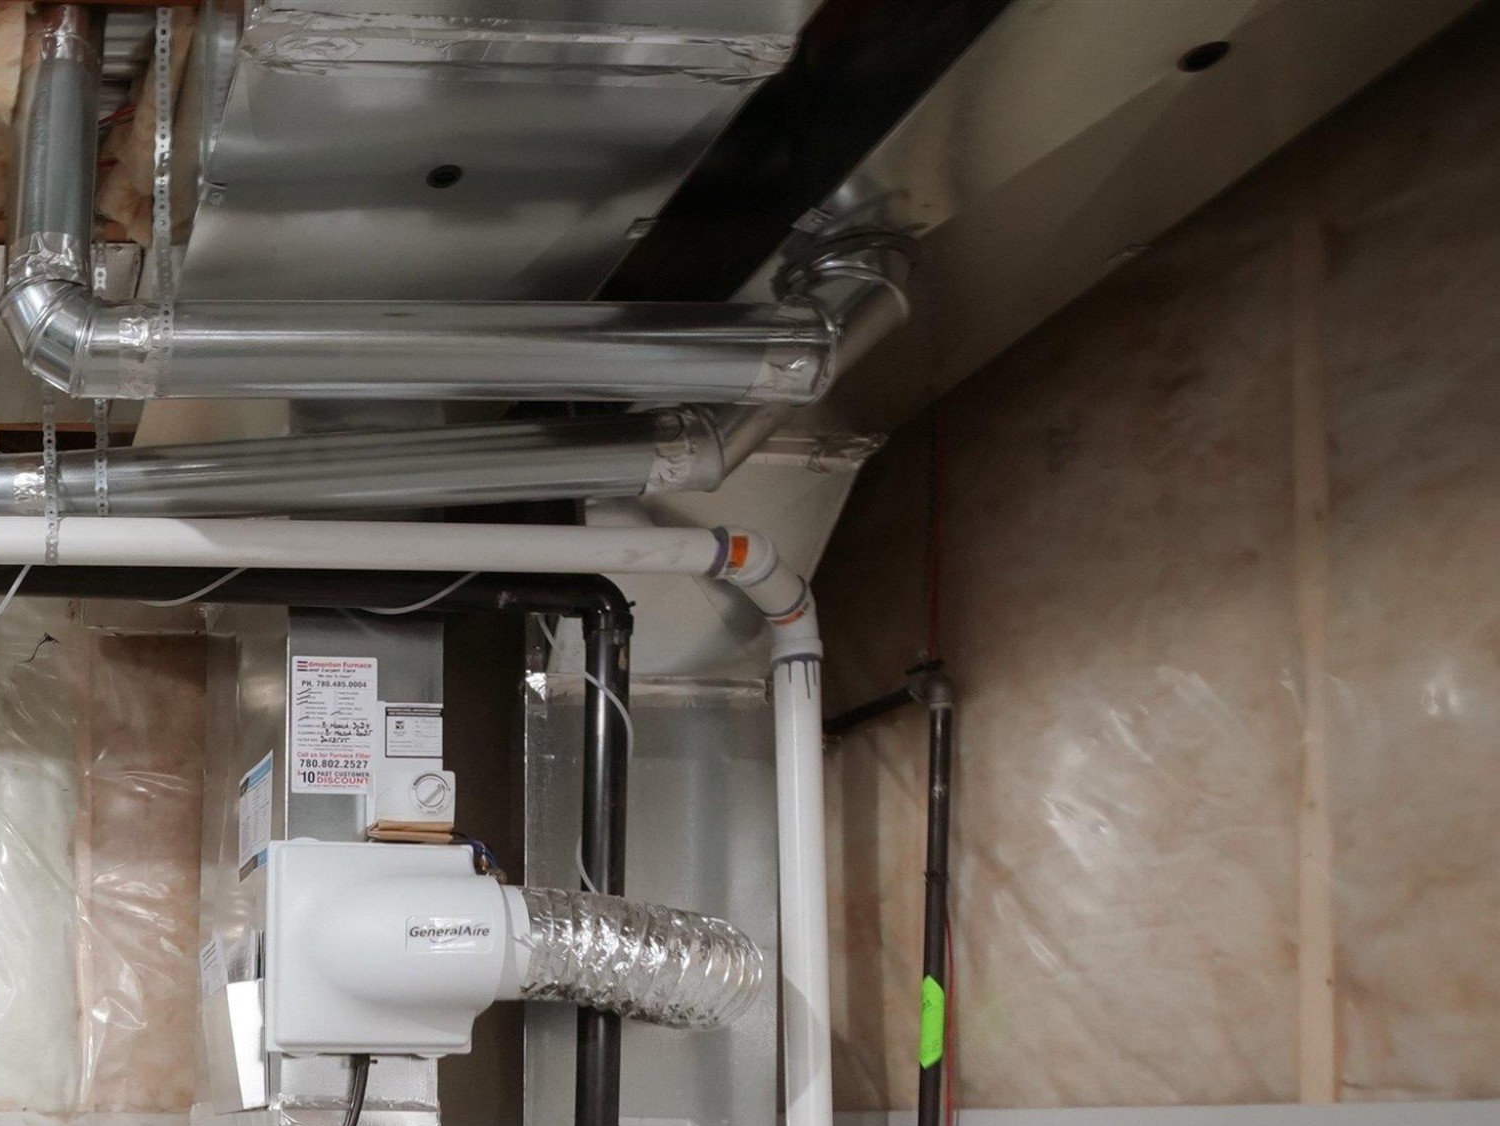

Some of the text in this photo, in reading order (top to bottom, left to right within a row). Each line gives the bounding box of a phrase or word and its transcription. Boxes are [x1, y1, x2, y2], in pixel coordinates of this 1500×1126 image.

[300, 759, 369, 769] 780.802.2527
[316, 777, 369, 785] DISCOUNT
[409, 925, 490, 938] GeneralAire
